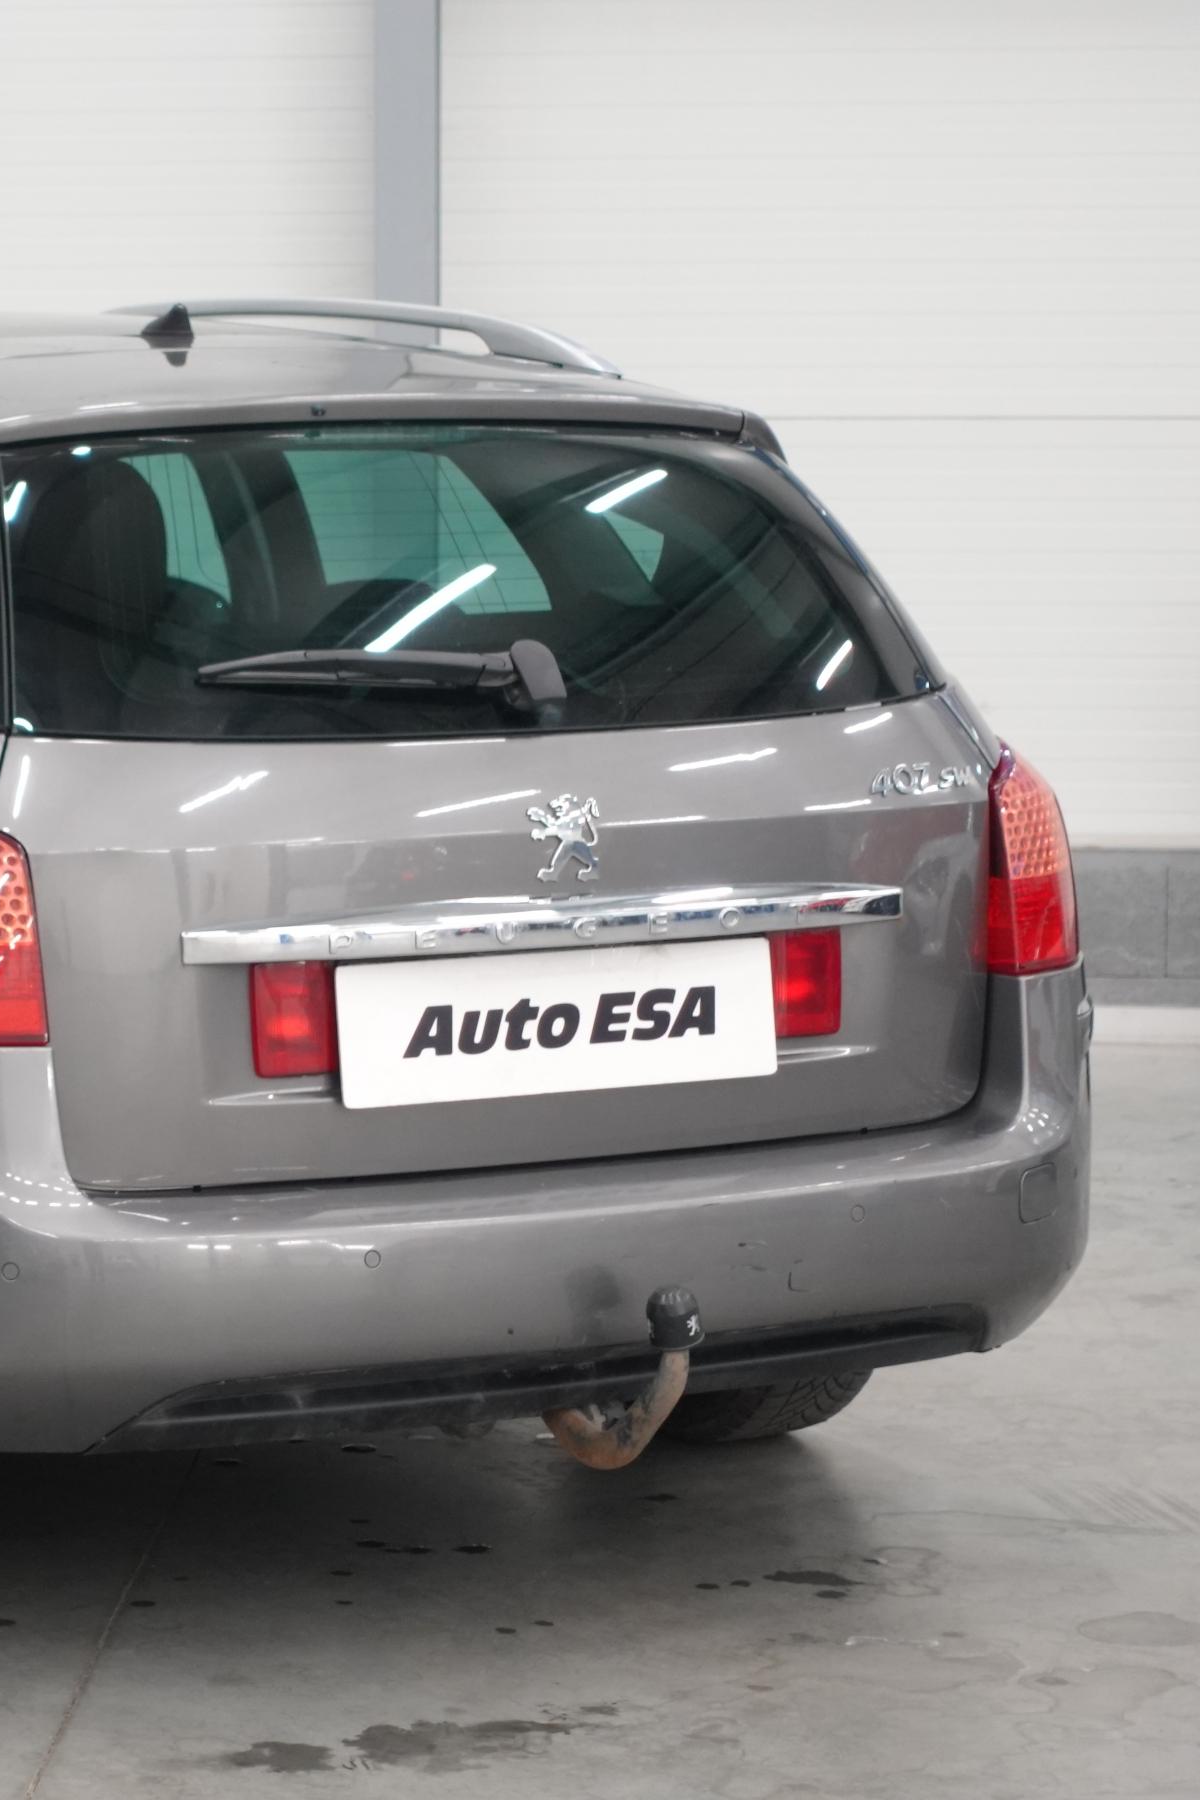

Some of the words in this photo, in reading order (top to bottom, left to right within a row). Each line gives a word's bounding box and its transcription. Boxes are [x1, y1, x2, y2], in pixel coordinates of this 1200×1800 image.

[871, 762, 931, 796] 407
[939, 765, 972, 789] SW
[328, 902, 808, 954] PEUGEOT
[404, 998, 580, 1058] Auto
[590, 986, 715, 1044] ESA
